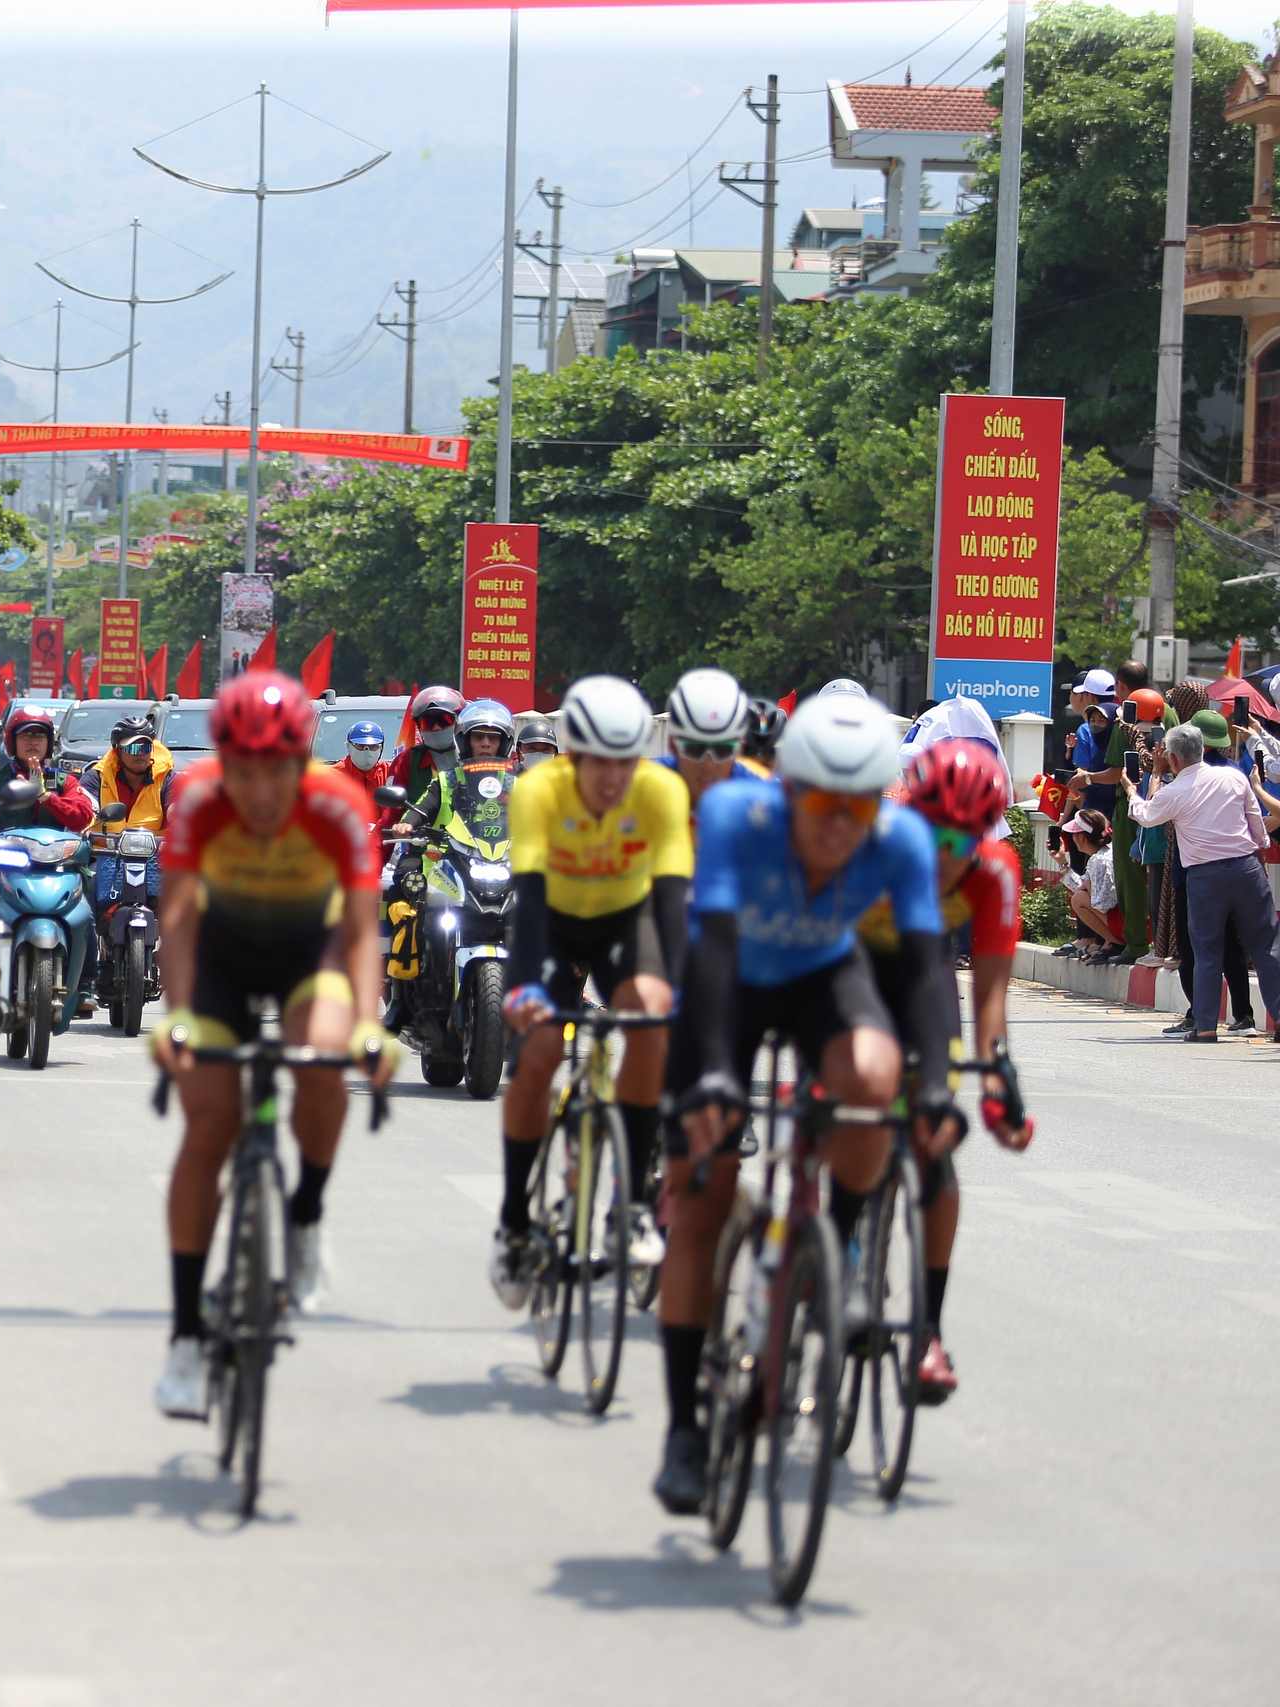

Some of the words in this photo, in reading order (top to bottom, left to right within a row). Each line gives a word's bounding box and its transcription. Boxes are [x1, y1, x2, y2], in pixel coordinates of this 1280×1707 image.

[983, 408, 1025, 441] SỐNG,
[964, 448, 1006, 478] CHIẾN
[1008, 449, 1040, 482] ĐẤU,
[967, 495, 993, 518] LAO
[996, 491, 1034, 523] ĐỘNG
[960, 530, 978, 557] VÀ
[981, 535, 1008, 563] HỌC
[1011, 532, 1038, 563] TẬP
[478, 577, 505, 594] NHIỆT
[505, 578, 524, 594] LIỆT
[955, 574, 989, 597] THEO
[992, 573, 1039, 599] GƯƠNG
[475, 595, 499, 609] CHÀO
[500, 596, 527, 609] MỪNG
[483, 614, 495, 626] 70
[496, 613, 517, 627] NĂM
[945, 609, 973, 637] BÁC
[975, 608, 994, 637] HỒ
[997, 612, 1012, 638] VĨ
[1013, 616, 1036, 643] ĐẠI
[471, 629, 498, 644] CHIẾN
[499, 630, 528, 645] THẮNG
[467, 648, 489, 663] ĐIỆN
[490, 647, 512, 662] BIÊN
[512, 647, 531, 662] PHỦ
[945, 678, 1040, 698] vinaphone
[483, 825, 502, 837] 77
